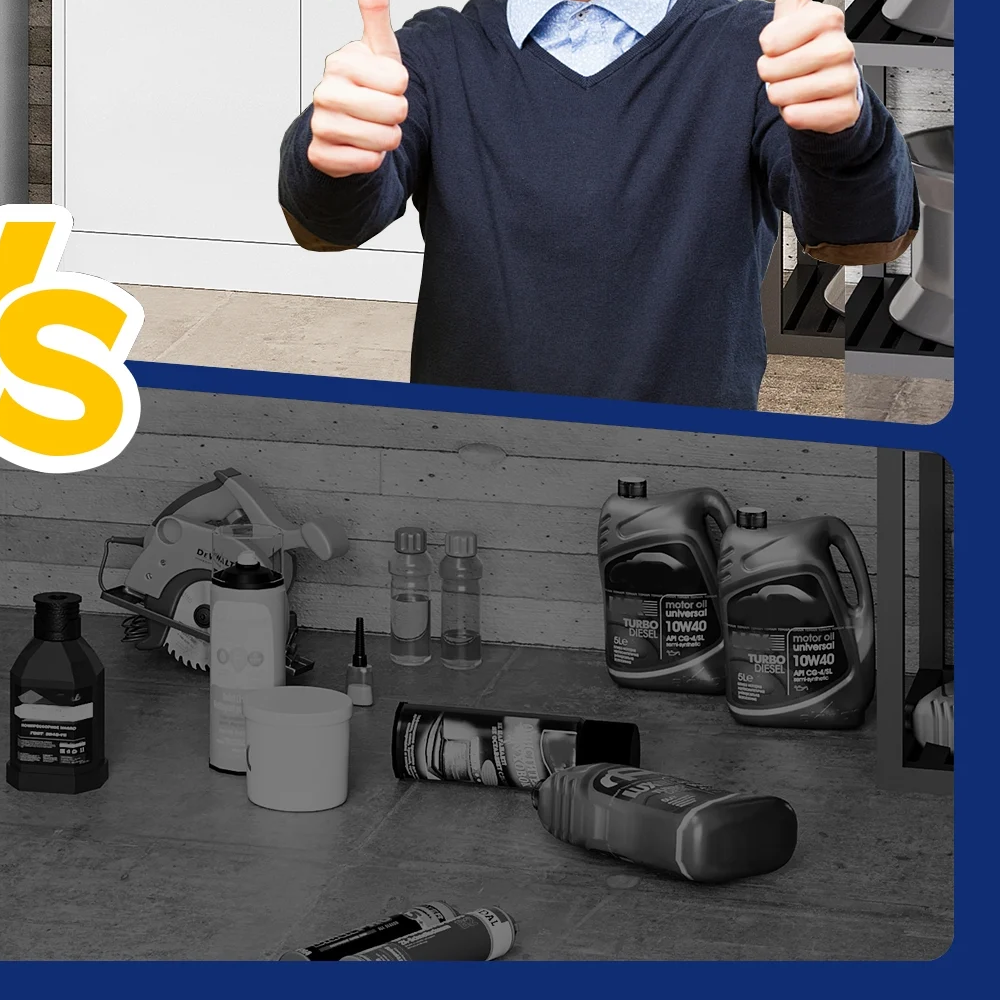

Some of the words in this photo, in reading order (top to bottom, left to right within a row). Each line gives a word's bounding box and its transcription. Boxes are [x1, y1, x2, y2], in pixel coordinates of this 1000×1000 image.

[696, 600, 707, 608] oil
[665, 610, 707, 618] universal
[623, 618, 659, 629] TURBO
[666, 620, 707, 632] 10W40
[629, 629, 658, 639] DIESEL
[793, 635, 822, 643] motor
[824, 632, 835, 642] oil
[614, 636, 629, 646] 5Le
[793, 641, 835, 652] universal
[748, 654, 786, 665] TURBO
[793, 653, 835, 667] 10W40
[754, 664, 785, 674] DIESEL
[738, 673, 754, 682] 5Le
